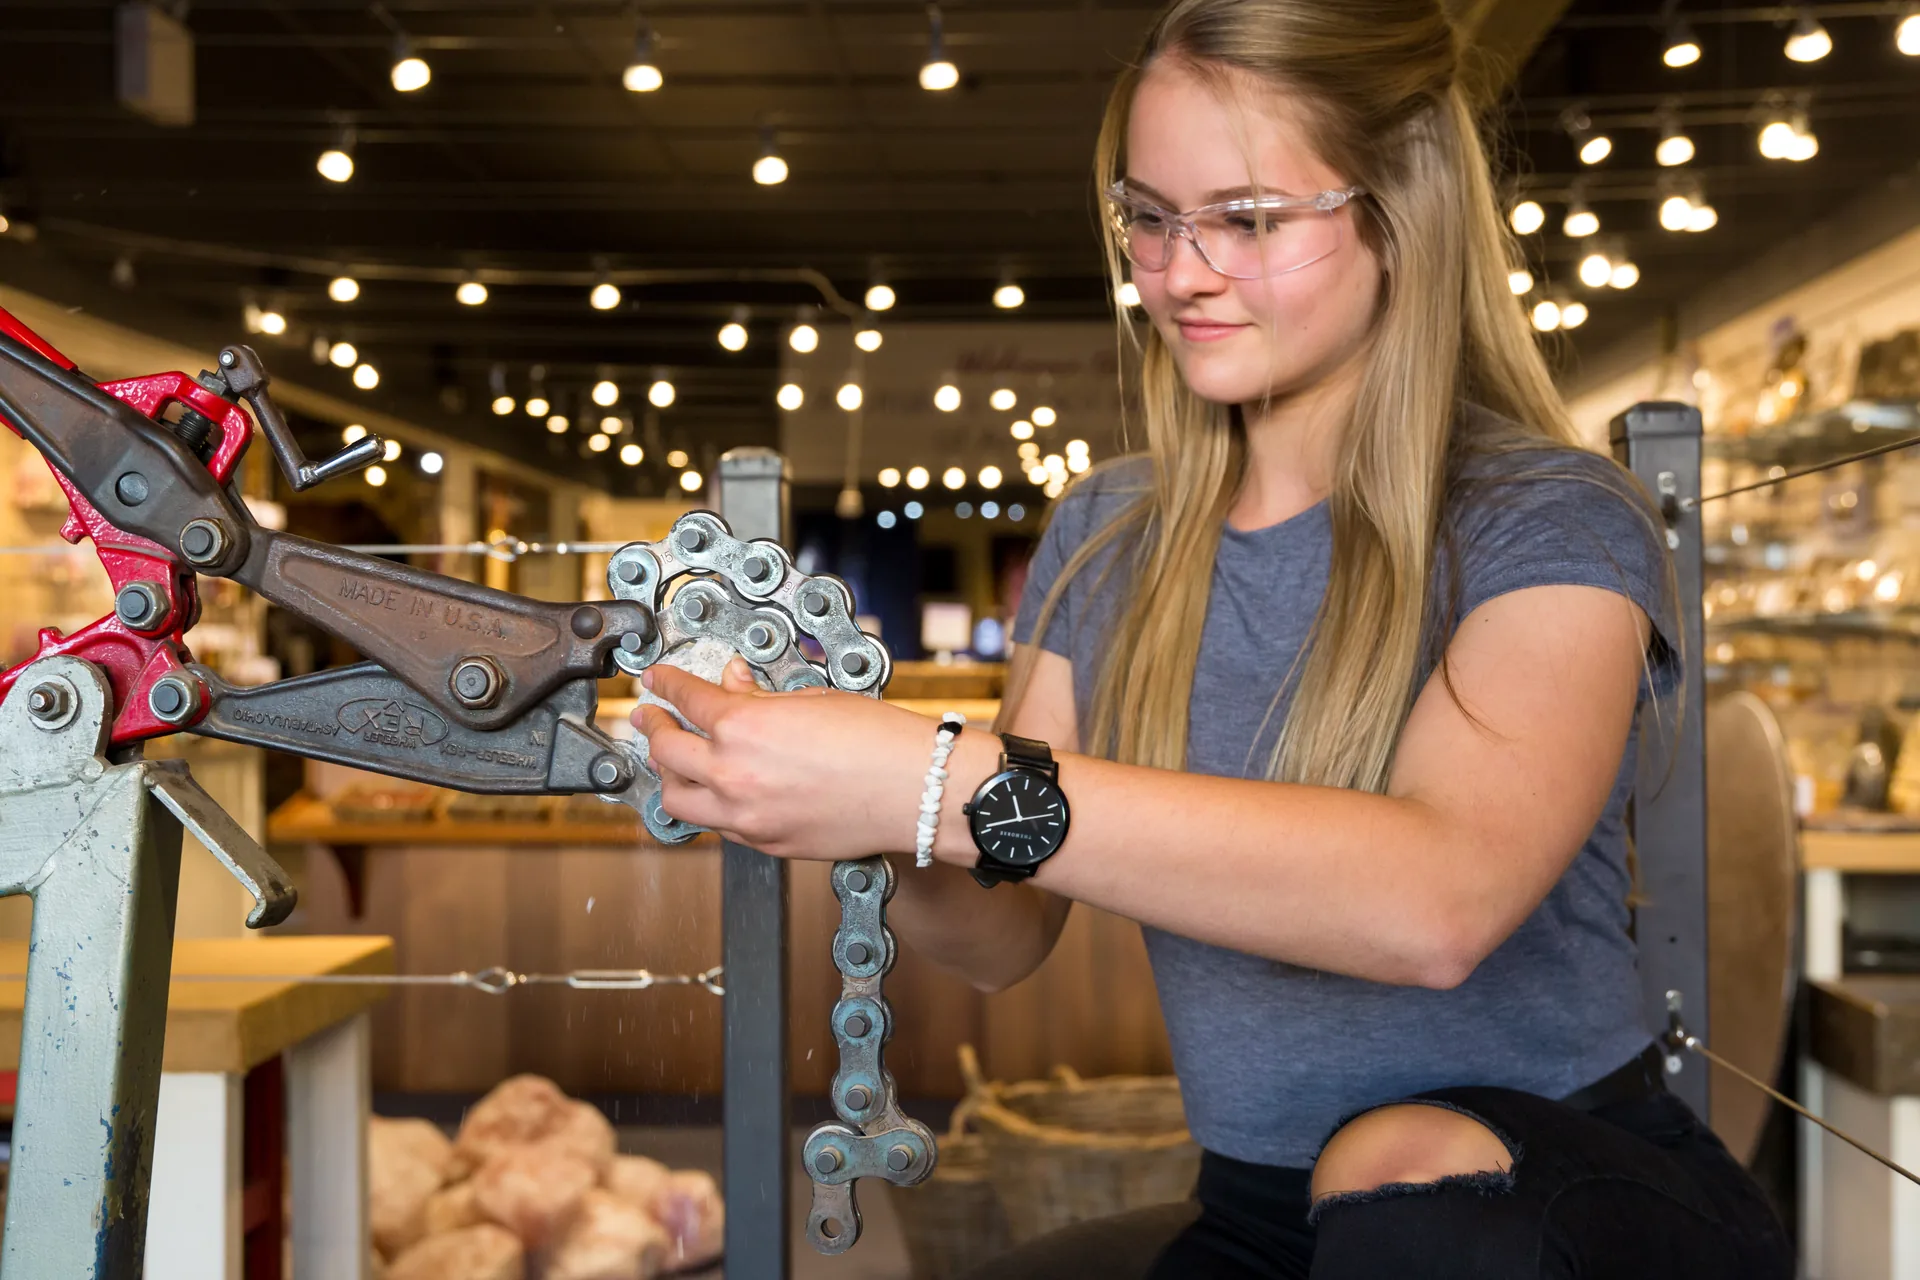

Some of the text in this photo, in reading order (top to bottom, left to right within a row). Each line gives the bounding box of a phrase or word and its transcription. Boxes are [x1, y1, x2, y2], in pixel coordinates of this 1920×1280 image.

[660, 551, 674, 564] 15
[339, 577, 507, 641] MADE IN U.S.A.
[363, 706, 425, 737] REX
[363, 731, 416, 750] WHEELER
